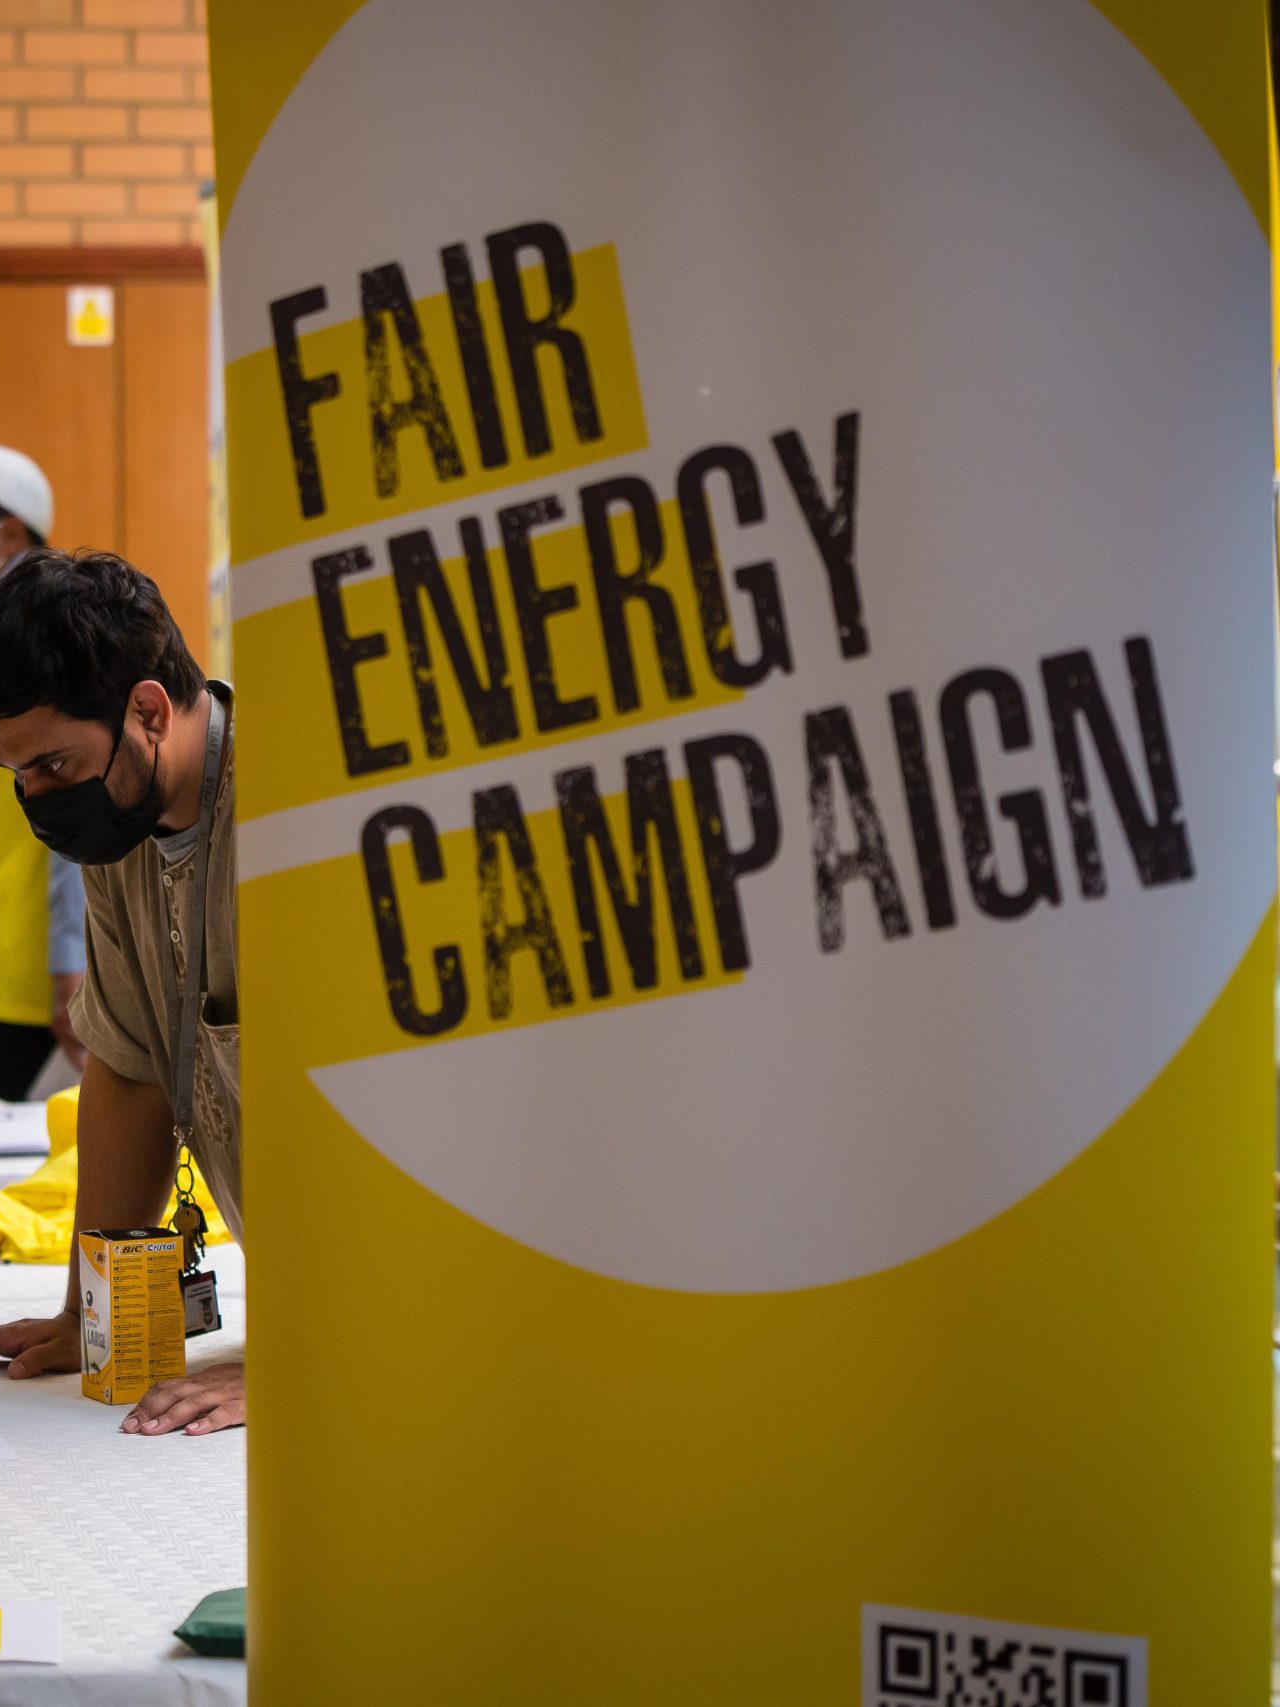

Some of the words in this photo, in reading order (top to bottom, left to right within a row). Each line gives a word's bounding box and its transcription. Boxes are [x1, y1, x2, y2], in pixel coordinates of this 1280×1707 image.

[270, 221, 604, 520] FAIR
[310, 410, 869, 779] ENERGY
[359, 635, 1196, 1040] CAMPAIGN
[147, 1242, 176, 1252] Cristal
